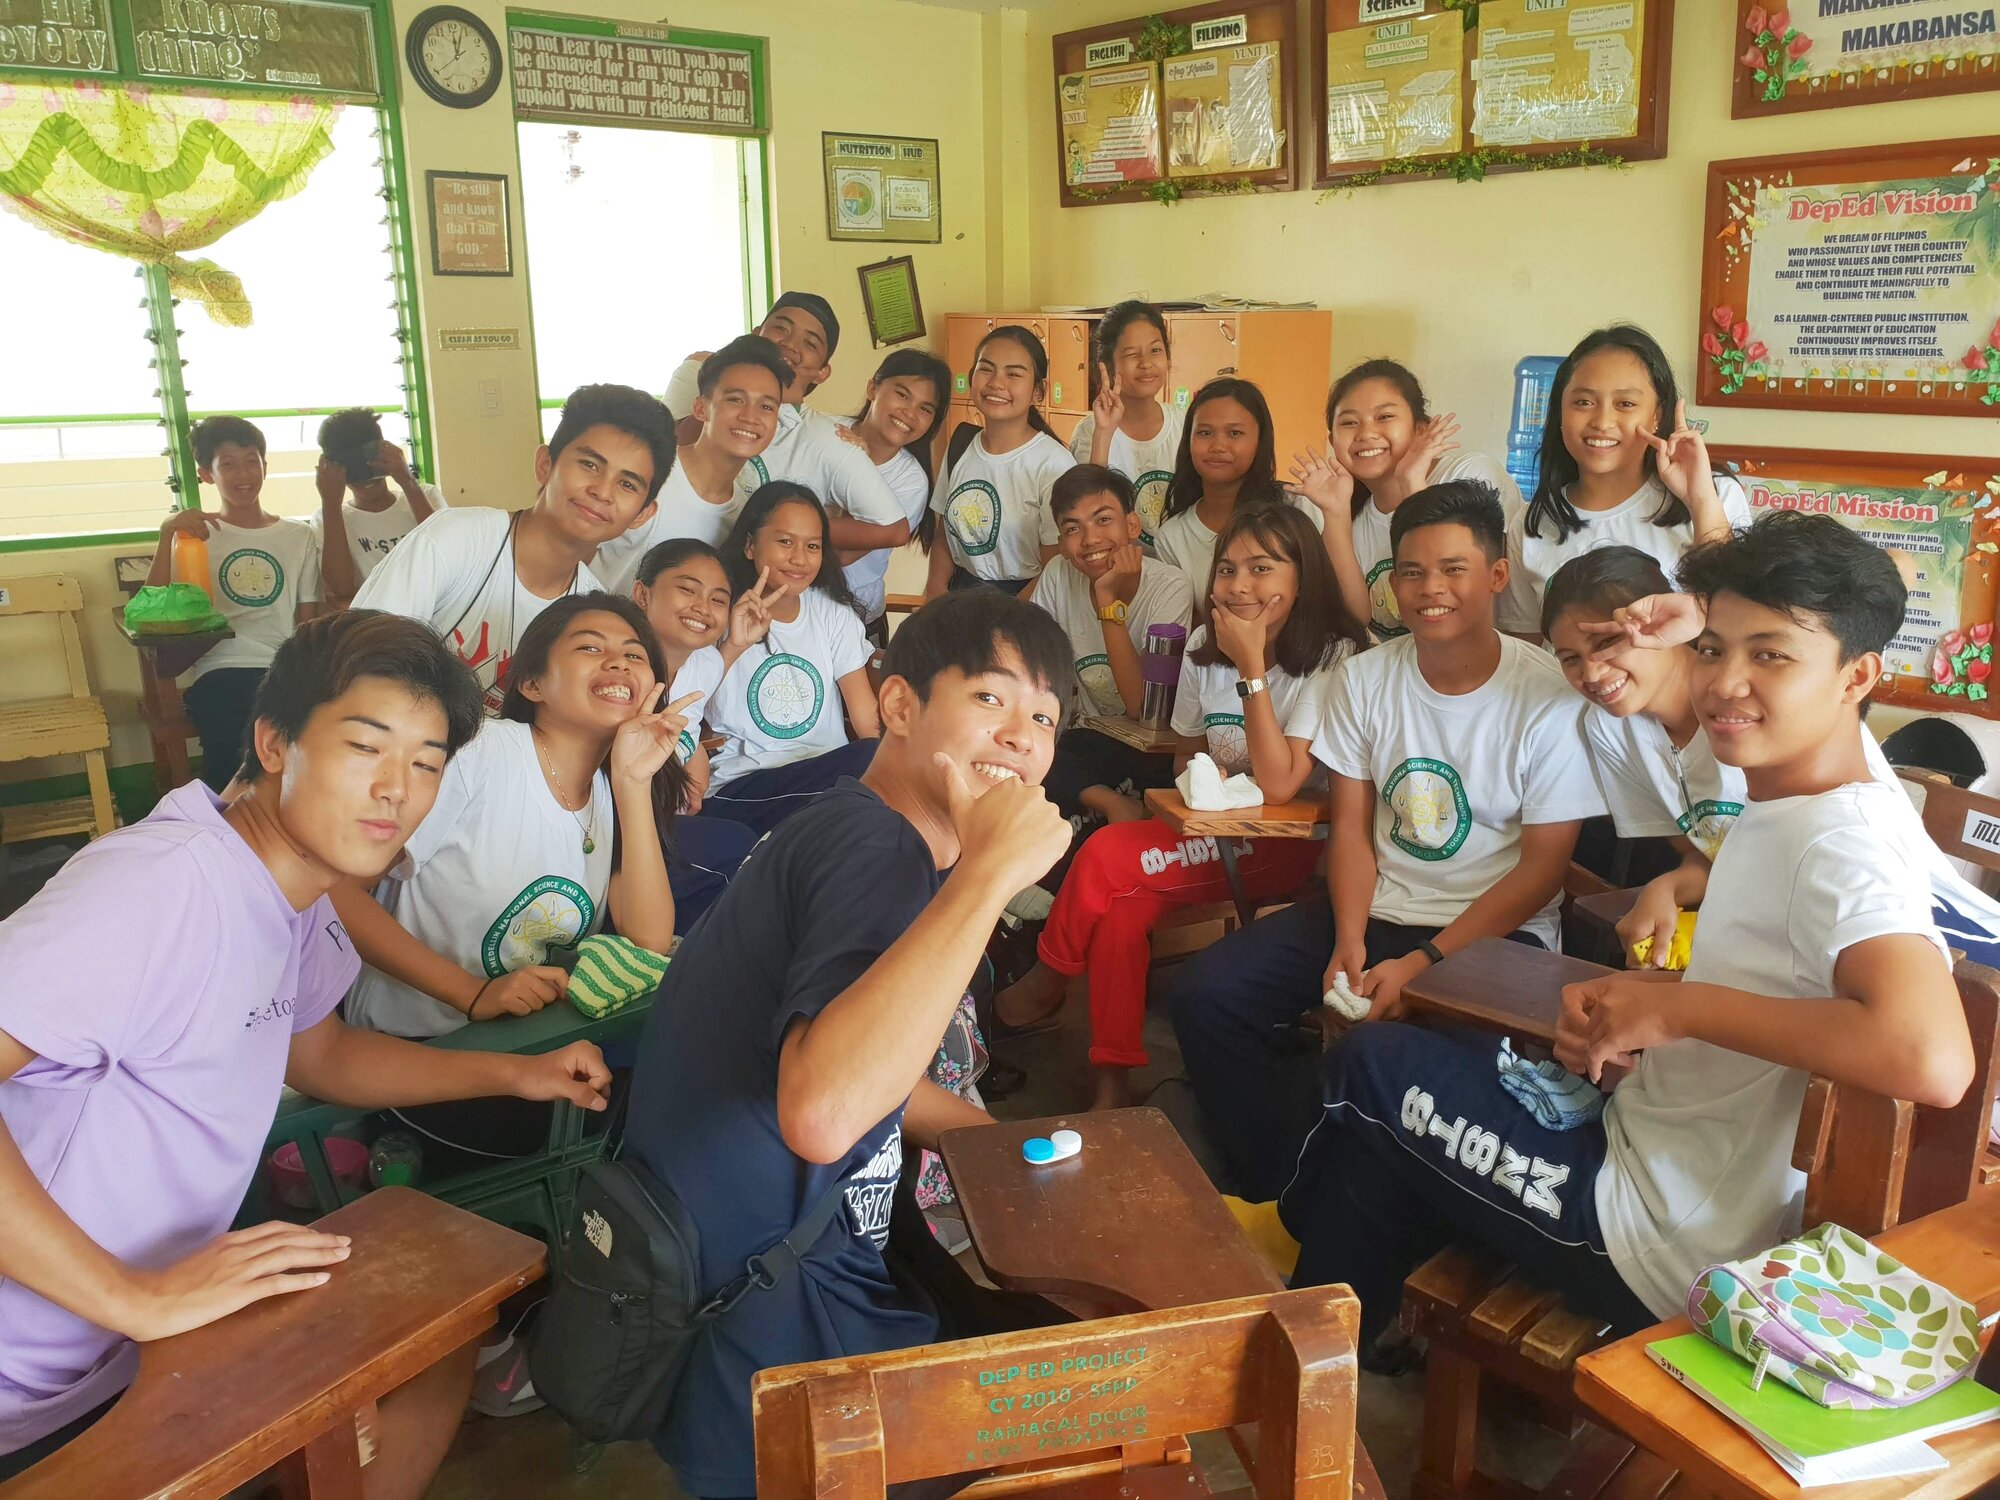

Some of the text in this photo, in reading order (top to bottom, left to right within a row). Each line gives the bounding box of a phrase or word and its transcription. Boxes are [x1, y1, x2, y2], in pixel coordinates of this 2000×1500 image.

[1526, 0, 1559, 12] UNIT
[1195, 22, 1241, 42] FILIPINO
[1378, 22, 1411, 39] UNIT 1
[1841, 9, 1997, 53] MAKABANSA
[427, 37, 437, 47] 10
[512, 31, 533, 50] Do
[535, 35, 560, 54] not
[593, 40, 614, 59] for
[616, 43, 624, 60] I
[626, 46, 648, 63] am
[650, 48, 681, 67] with
[425, 52, 434, 62] 9
[1089, 44, 1126, 62] ENGLISH
[1234, 44, 1270, 59] YUNIT 1
[513, 49, 533, 68] be
[535, 51, 603, 75] dismayed
[605, 58, 625, 77] for
[627, 61, 635, 79] I
[637, 63, 658, 80] am
[661, 66, 691, 84] your
[726, 72, 734, 90] I
[513, 69, 746, 106] will strengthen and help you. I will
[515, 86, 749, 124] uphold you with my righteous hand.
[839, 143, 923, 158] NUTRITION HUB
[470, 183, 490, 196] still
[442, 202, 497, 217] and know
[1788, 190, 1974, 223] DepEd Vision
[446, 221, 497, 236] that I am
[1823, 230, 1928, 244] WE DREAM OF FILIPINOS
[1787, 240, 1968, 257] WHO PASSIONATELY LOVE THEIR COUNTRY
[1787, 252, 1963, 268] AND WHOSE VALUES AND COMPETENCIES
[1774, 264, 1976, 279] ENABLE THEM TO REALIZE THEIR FULL POTENTIAL
[1795, 277, 1950, 290] AND CONTRIBUTE MEANINGFULLY TO
[1822, 289, 1917, 301] BUILDING THE NATION.
[1773, 314, 1785, 323] AS
[1785, 314, 1791, 323] A
[1792, 313, 1873, 323] LEARNER-CENTERED
[1874, 313, 1907, 322] PUBLIC
[1800, 324, 1937, 334] THE DEPARTMENT OF EDUCATION
[448, 335, 473, 344] CLEAN
[482, 335, 500, 343] YOU
[1796, 336, 1938, 345] CONTINUOUSLY IMPROVES ITSELF
[1788, 347, 1945, 357] TO BETTER SERVE ITS STAKEHOLDERS.
[1834, 494, 1936, 522] Mission
[1871, 531, 1939, 544] OF EVERY FILIPINO
[1879, 541, 1919, 552] COMPLETE
[1918, 544, 1943, 553] BASIC
[1902, 635, 1937, 646] ACTIVELY
[752, 664, 770, 691] NATIONAL
[803, 664, 821, 699] TECHNOLOGY
[1210, 717, 1239, 725] SCIENCE
[1406, 761, 1438, 771] SCIENCE
[1439, 767, 1454, 779] AND
[1386, 767, 1407, 796] NATIONA
[1452, 778, 1468, 821] TECHNOLOGY
[1446, 822, 1467, 850] SCHOOL
[488, 880, 579, 968] MEDELLIN NATIONAL SCIENCE AND
[1060, 1346, 1148, 1375] PROJECT
[988, 1396, 1016, 1414] CY
[1088, 1404, 1148, 1427] DOOR
